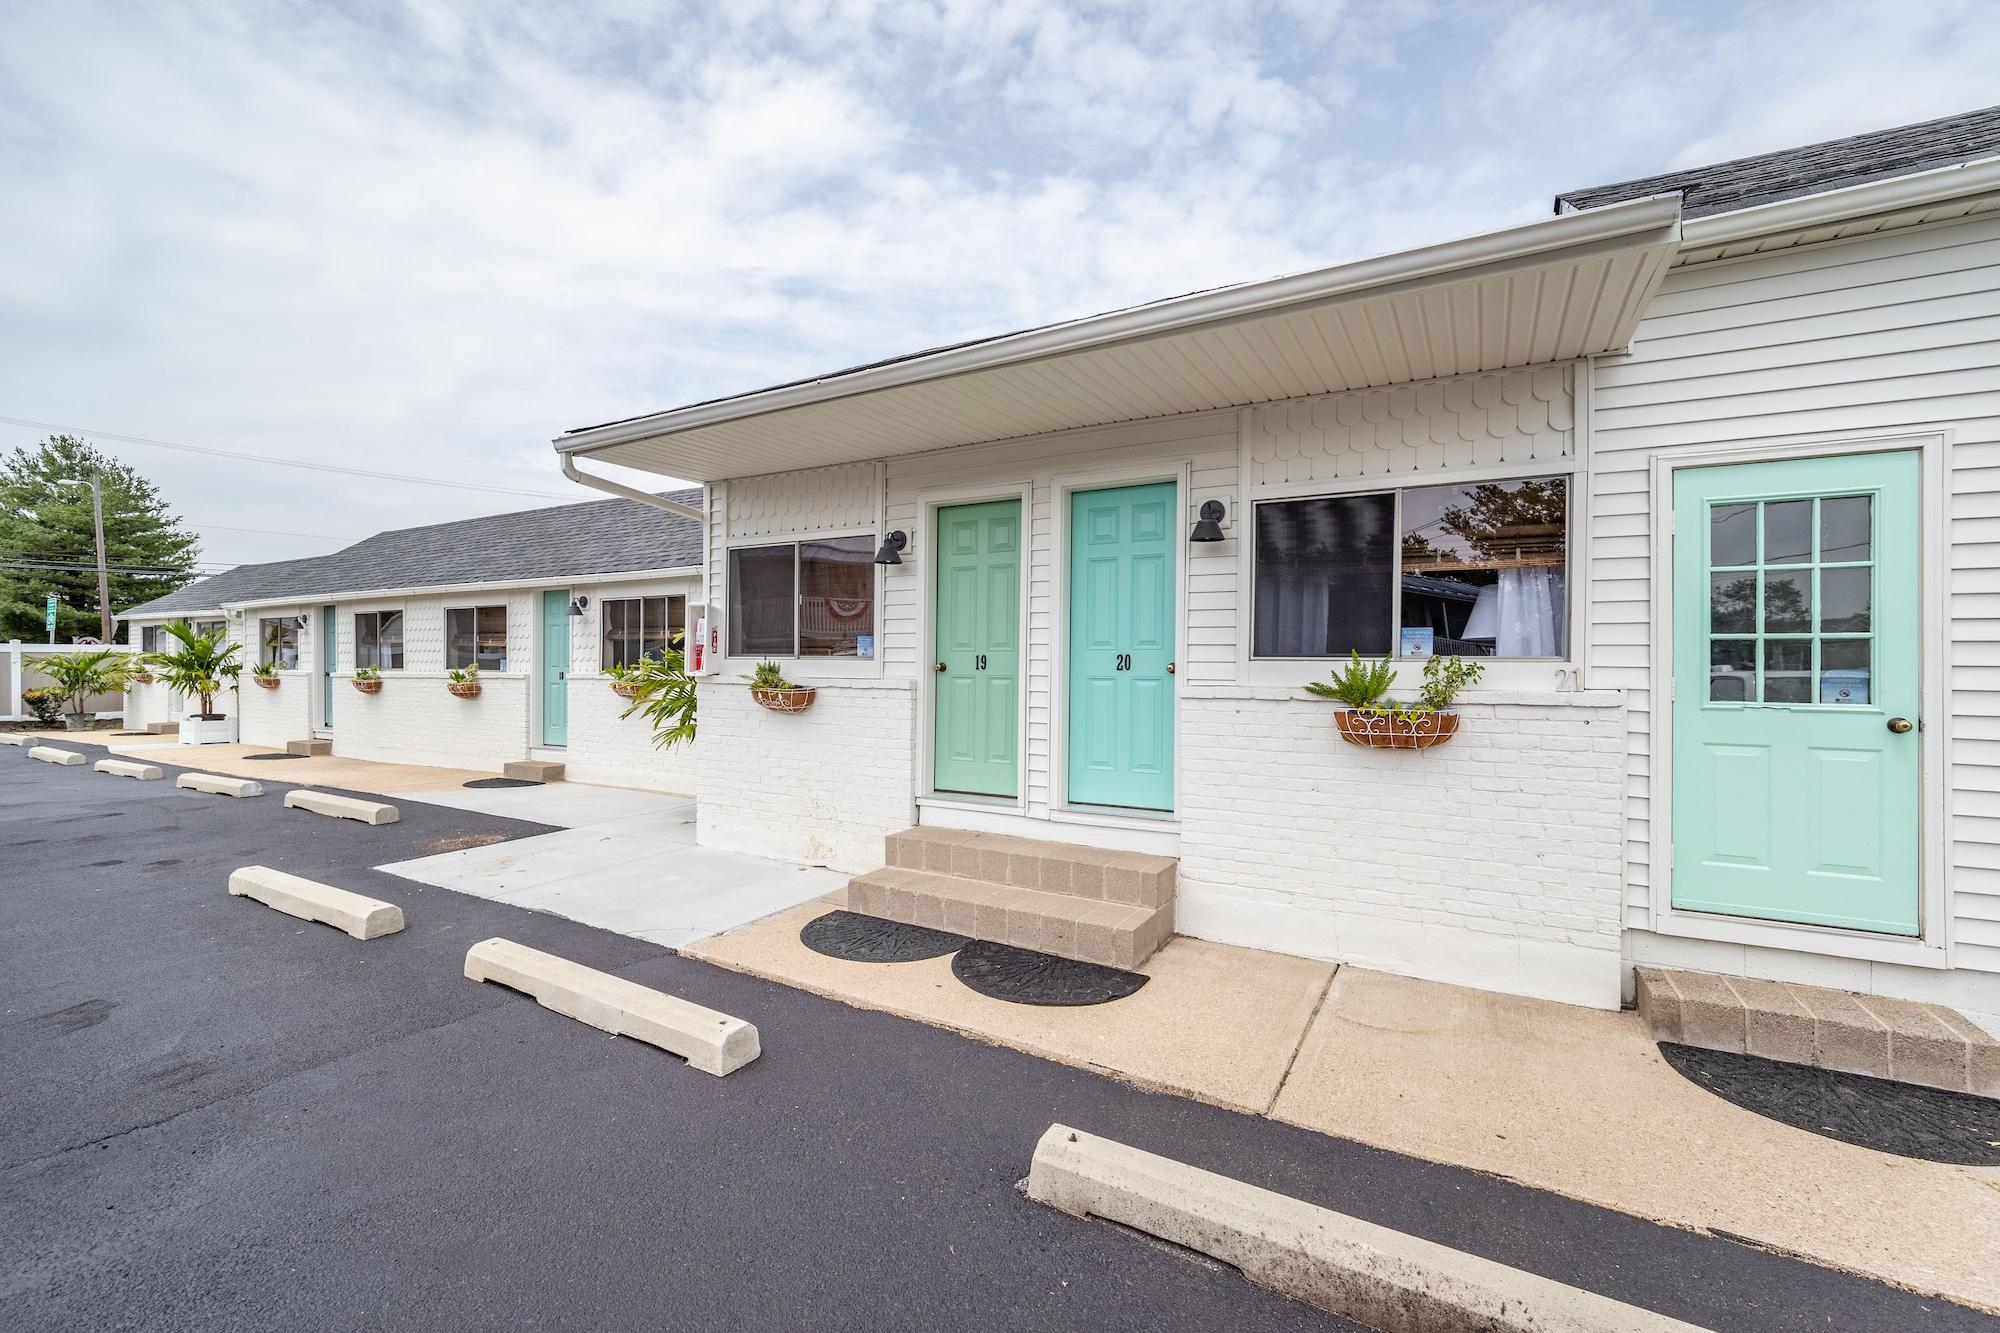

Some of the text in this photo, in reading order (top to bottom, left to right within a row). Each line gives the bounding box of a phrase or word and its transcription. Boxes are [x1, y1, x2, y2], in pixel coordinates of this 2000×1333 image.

[975, 654, 987, 670] 19
[1116, 654, 1131, 671] 20
[1555, 668, 1584, 692] 21
